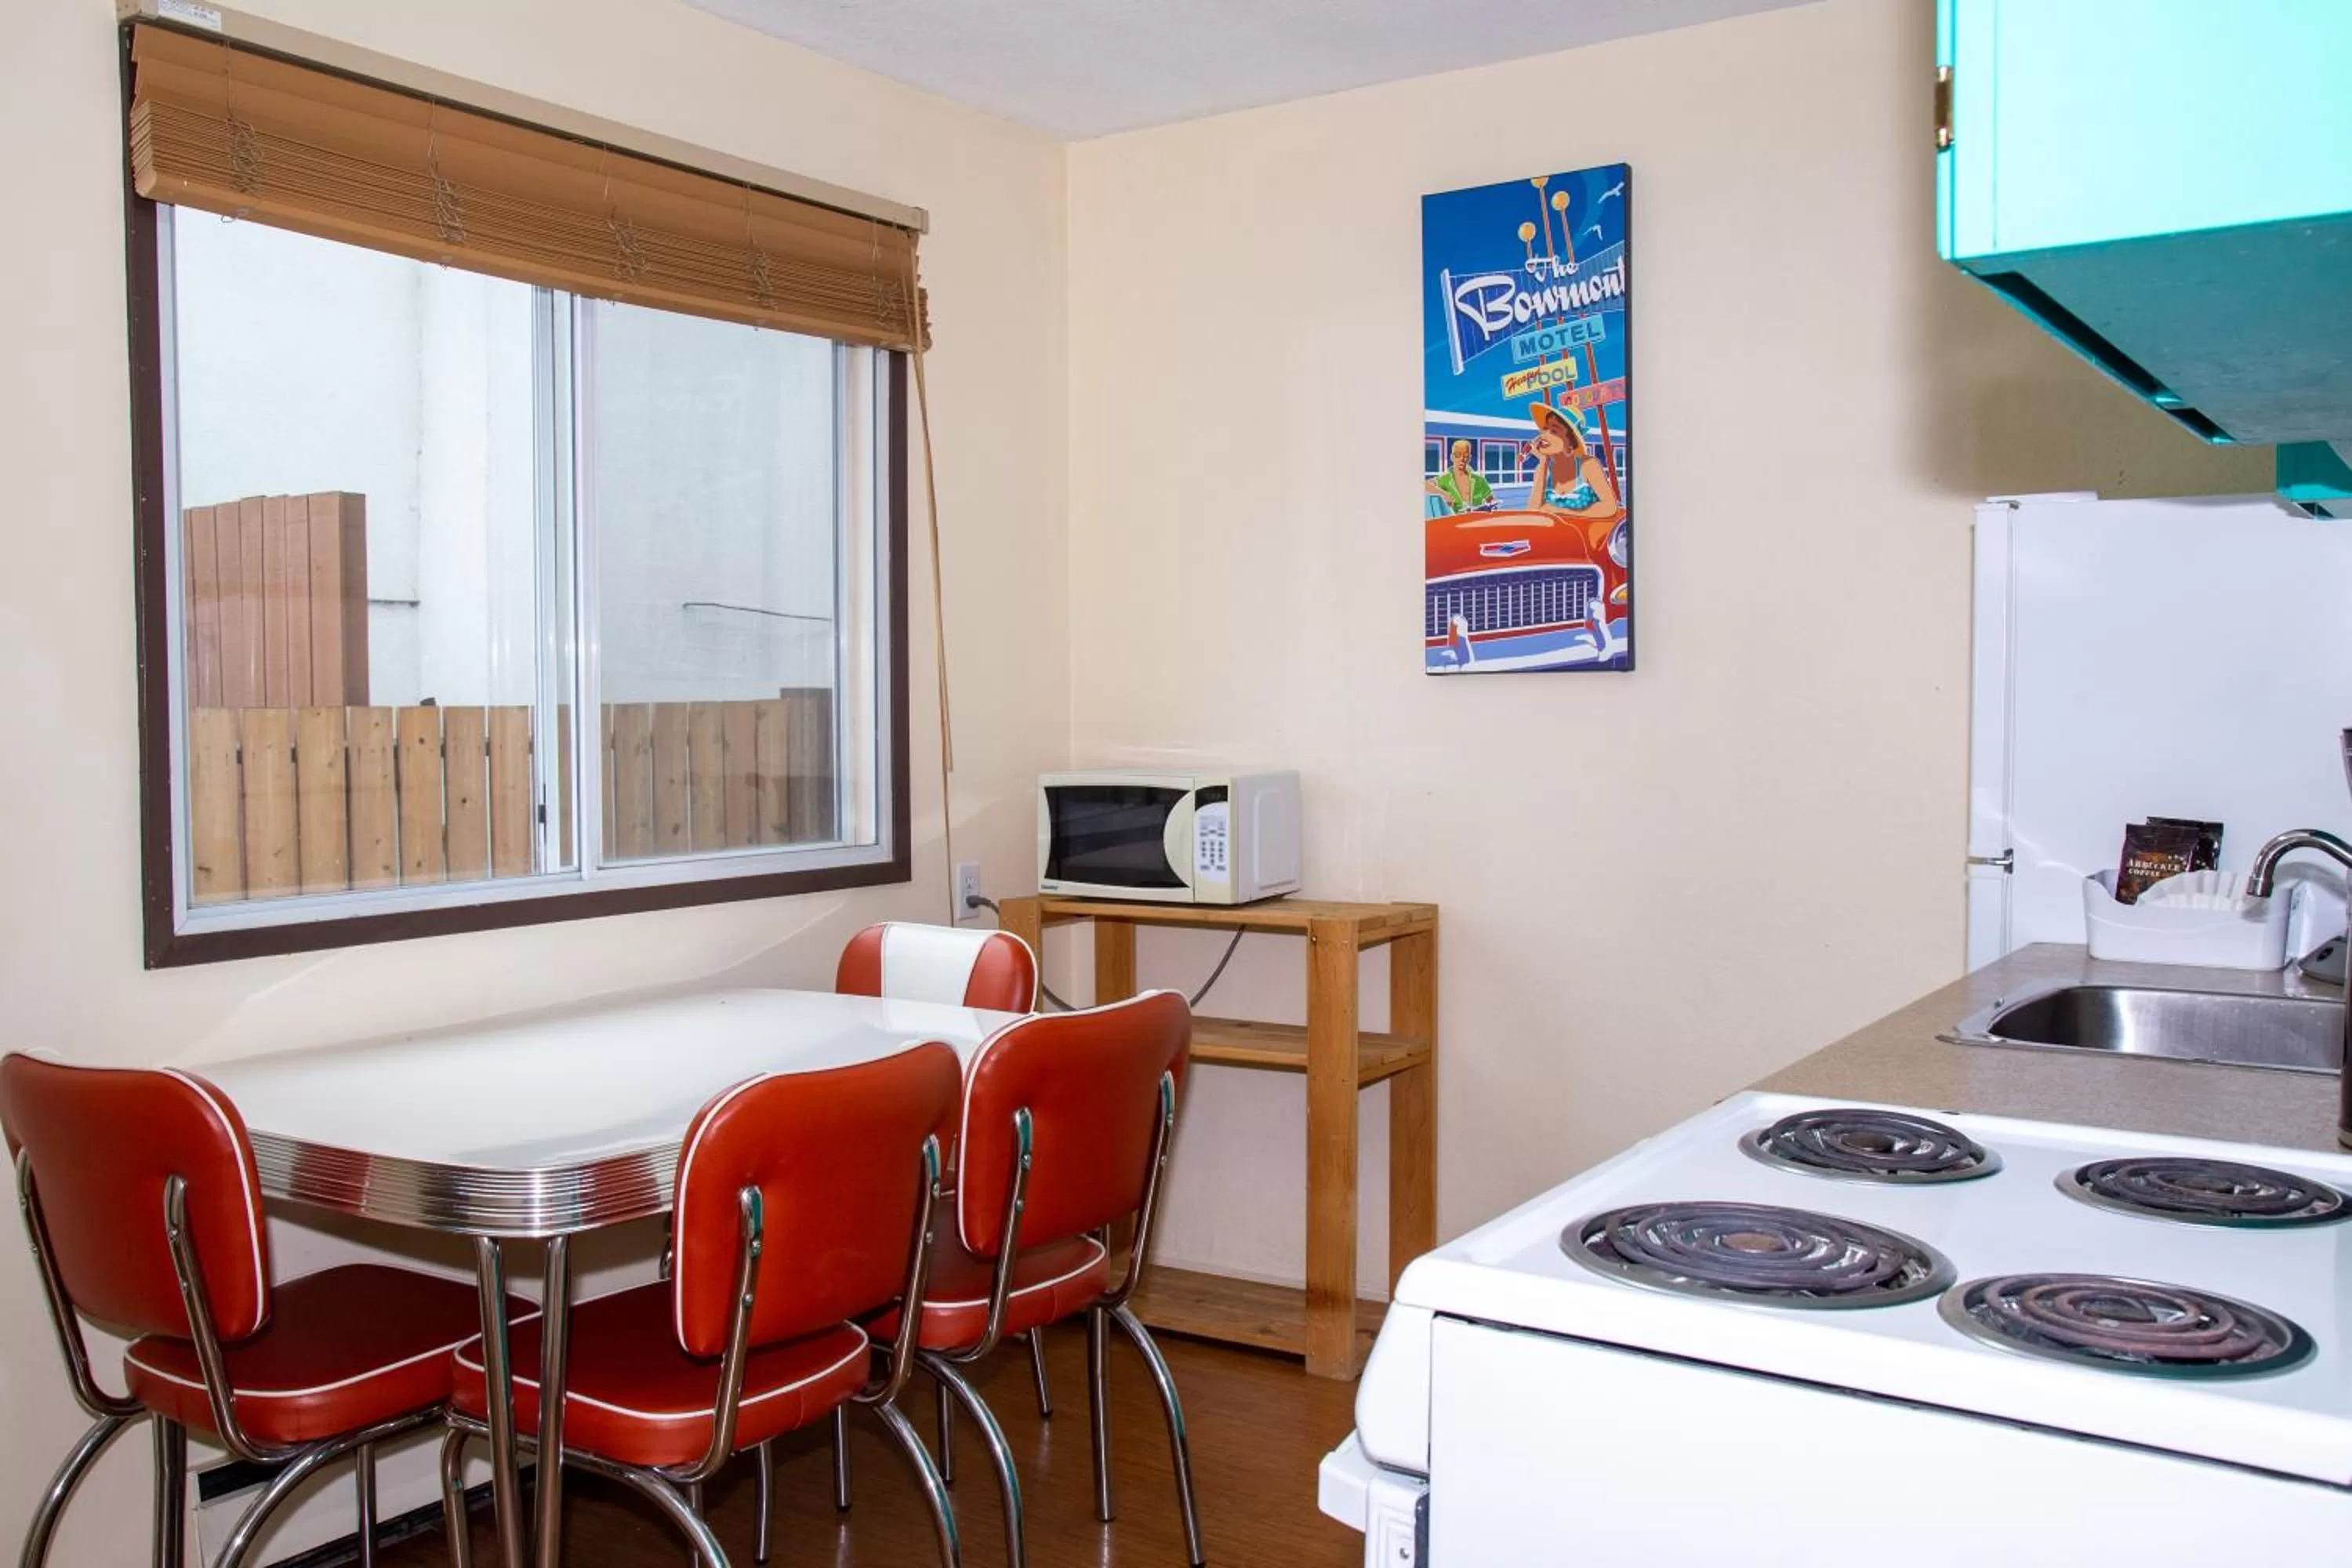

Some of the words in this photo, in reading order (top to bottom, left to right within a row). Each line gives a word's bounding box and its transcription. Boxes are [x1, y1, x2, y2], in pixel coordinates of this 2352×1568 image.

[1525, 254, 1579, 281] The
[1454, 256, 1625, 341] Bowmont
[1519, 321, 1601, 357] MOTEL
[1527, 365, 1577, 390] POOL
